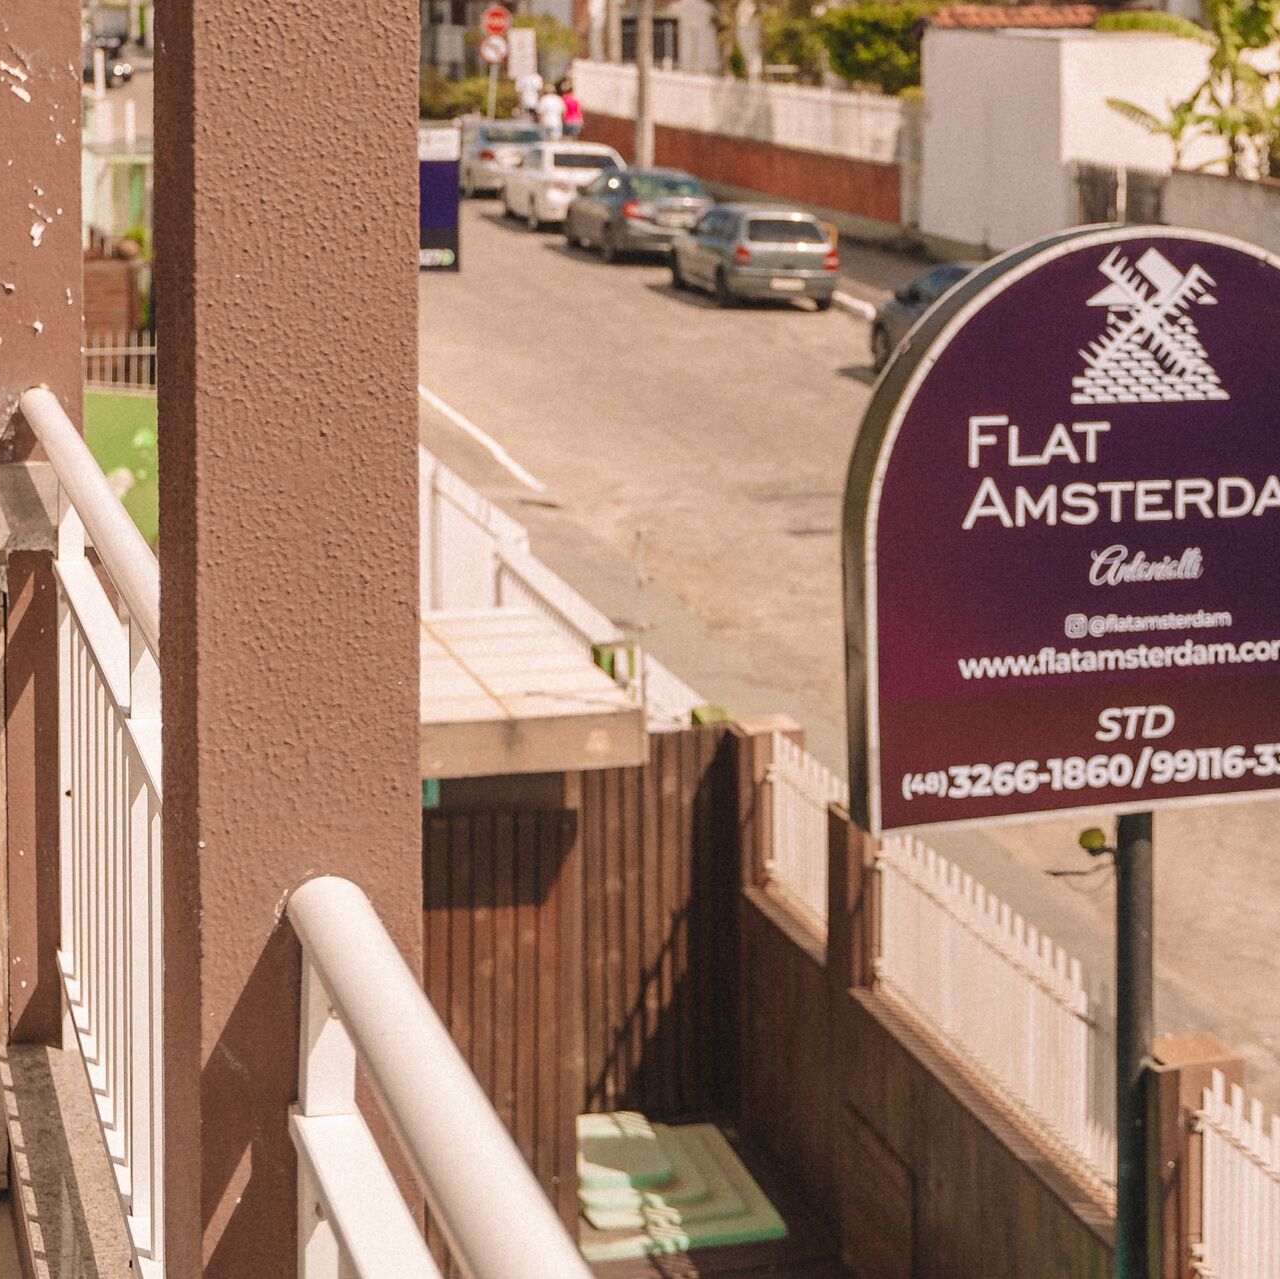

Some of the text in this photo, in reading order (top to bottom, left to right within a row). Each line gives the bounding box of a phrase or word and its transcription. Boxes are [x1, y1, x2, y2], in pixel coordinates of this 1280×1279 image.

[968, 414, 1111, 469] FLAT
[1088, 609, 1233, 638] @flatamsterdam
[1095, 704, 1176, 742] STD
